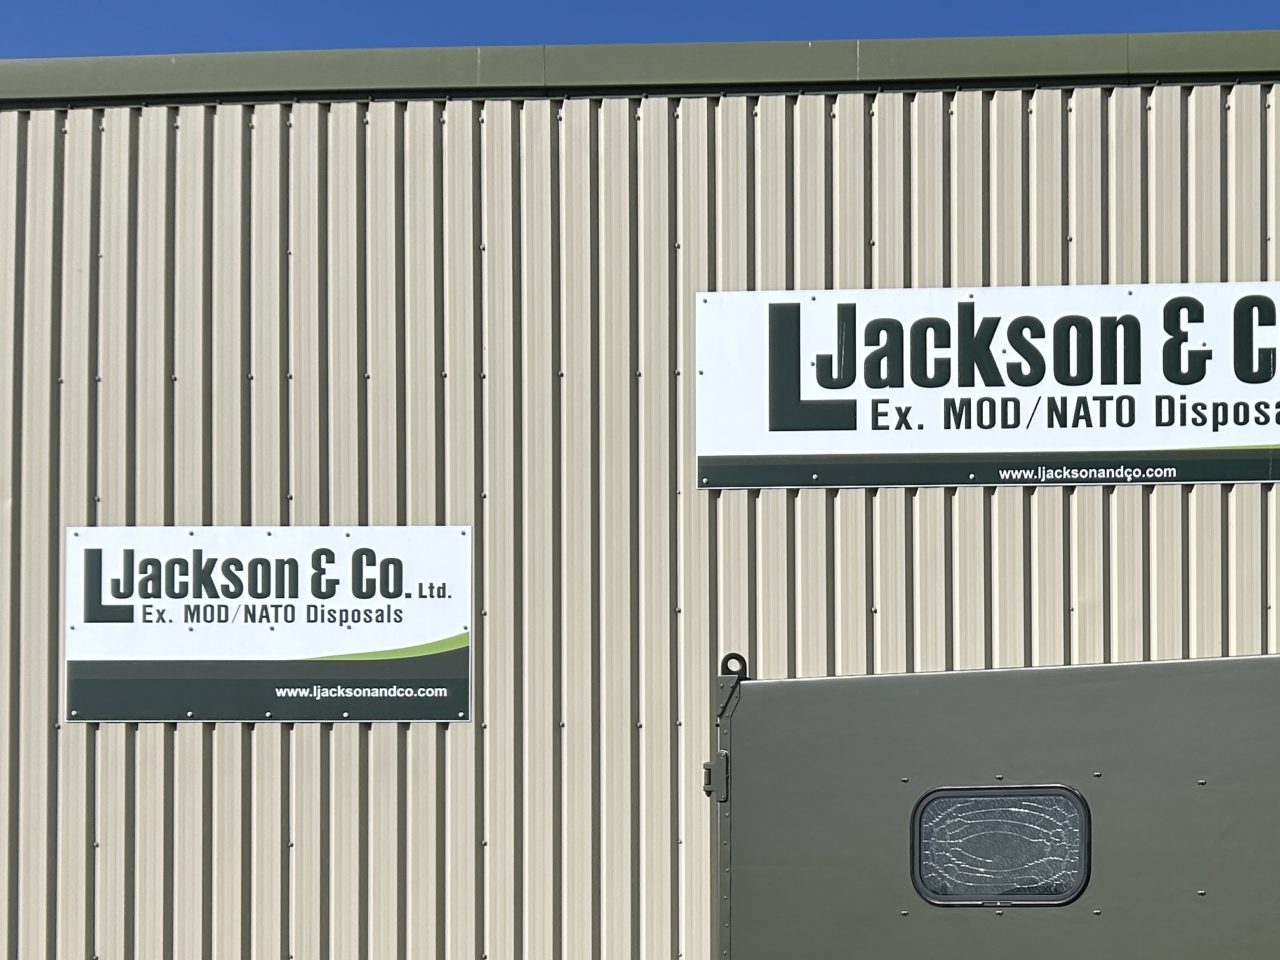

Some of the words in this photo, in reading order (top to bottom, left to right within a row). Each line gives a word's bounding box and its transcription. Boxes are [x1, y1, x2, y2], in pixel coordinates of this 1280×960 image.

[1163, 297, 1213, 386] &
[871, 399, 924, 431] Ex.
[943, 395, 1136, 430] MOD/NATO
[998, 465, 1177, 482] www.ljacksonandco.com
[310, 547, 340, 600] &
[351, 547, 412, 600] Co.
[418, 582, 452, 599] Ltd.
[142, 604, 173, 624] Ex.
[183, 604, 296, 624] MOD/NATO
[306, 604, 403, 627] Disposals
[274, 685, 448, 700] www.ljacksonandco.com
